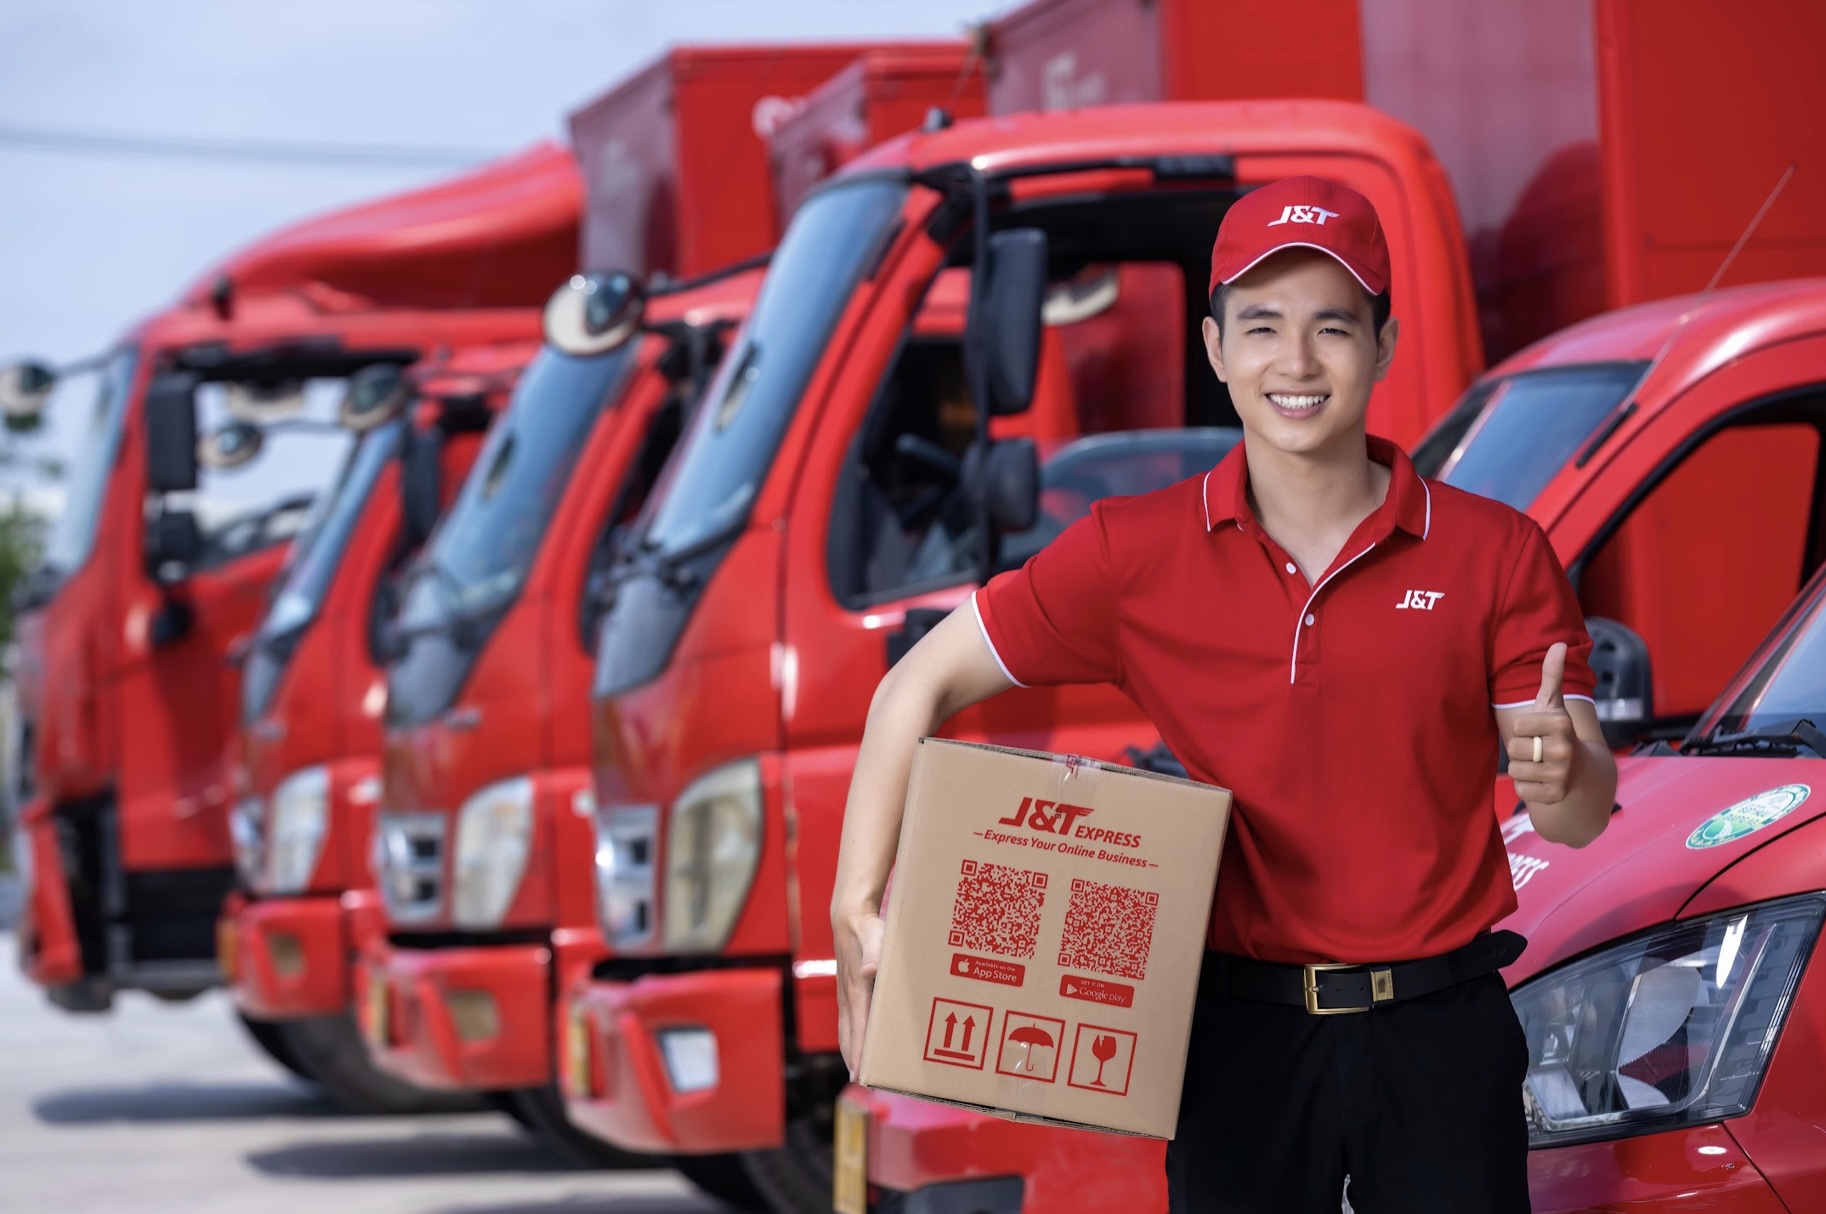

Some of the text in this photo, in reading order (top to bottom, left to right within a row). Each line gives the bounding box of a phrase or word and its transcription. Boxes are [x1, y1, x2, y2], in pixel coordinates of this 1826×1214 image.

[1266, 205, 1340, 227] J&T
[1395, 589, 1446, 611] J&T
[998, 796, 1142, 848] J&T EXPRESS
[1031, 837, 1056, 851] Your
[1058, 843, 1096, 858] Online
[973, 967, 1018, 982] App Store
[1079, 987, 1126, 1004] Google play
